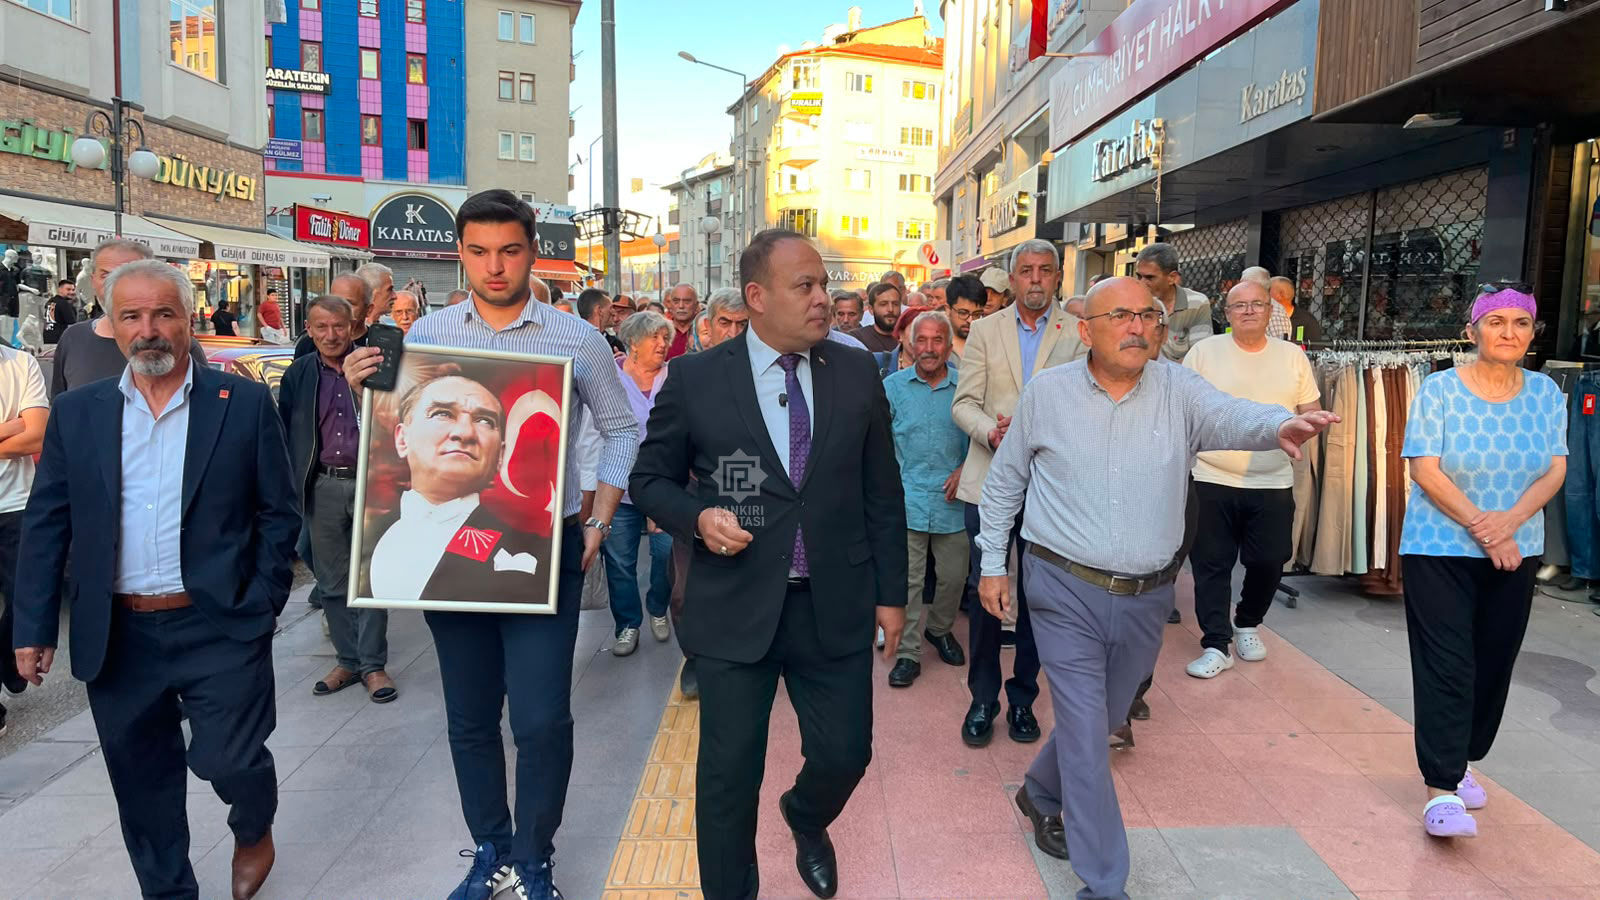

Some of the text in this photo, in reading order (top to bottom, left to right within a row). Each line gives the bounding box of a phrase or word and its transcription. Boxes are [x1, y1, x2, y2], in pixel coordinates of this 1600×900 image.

[1073, 21, 1157, 116] CUMHURİYET
[0, 117, 110, 172] GİYİ
[153, 153, 256, 201] DÜNYASI
[310, 214, 361, 242] Fatih Döner
